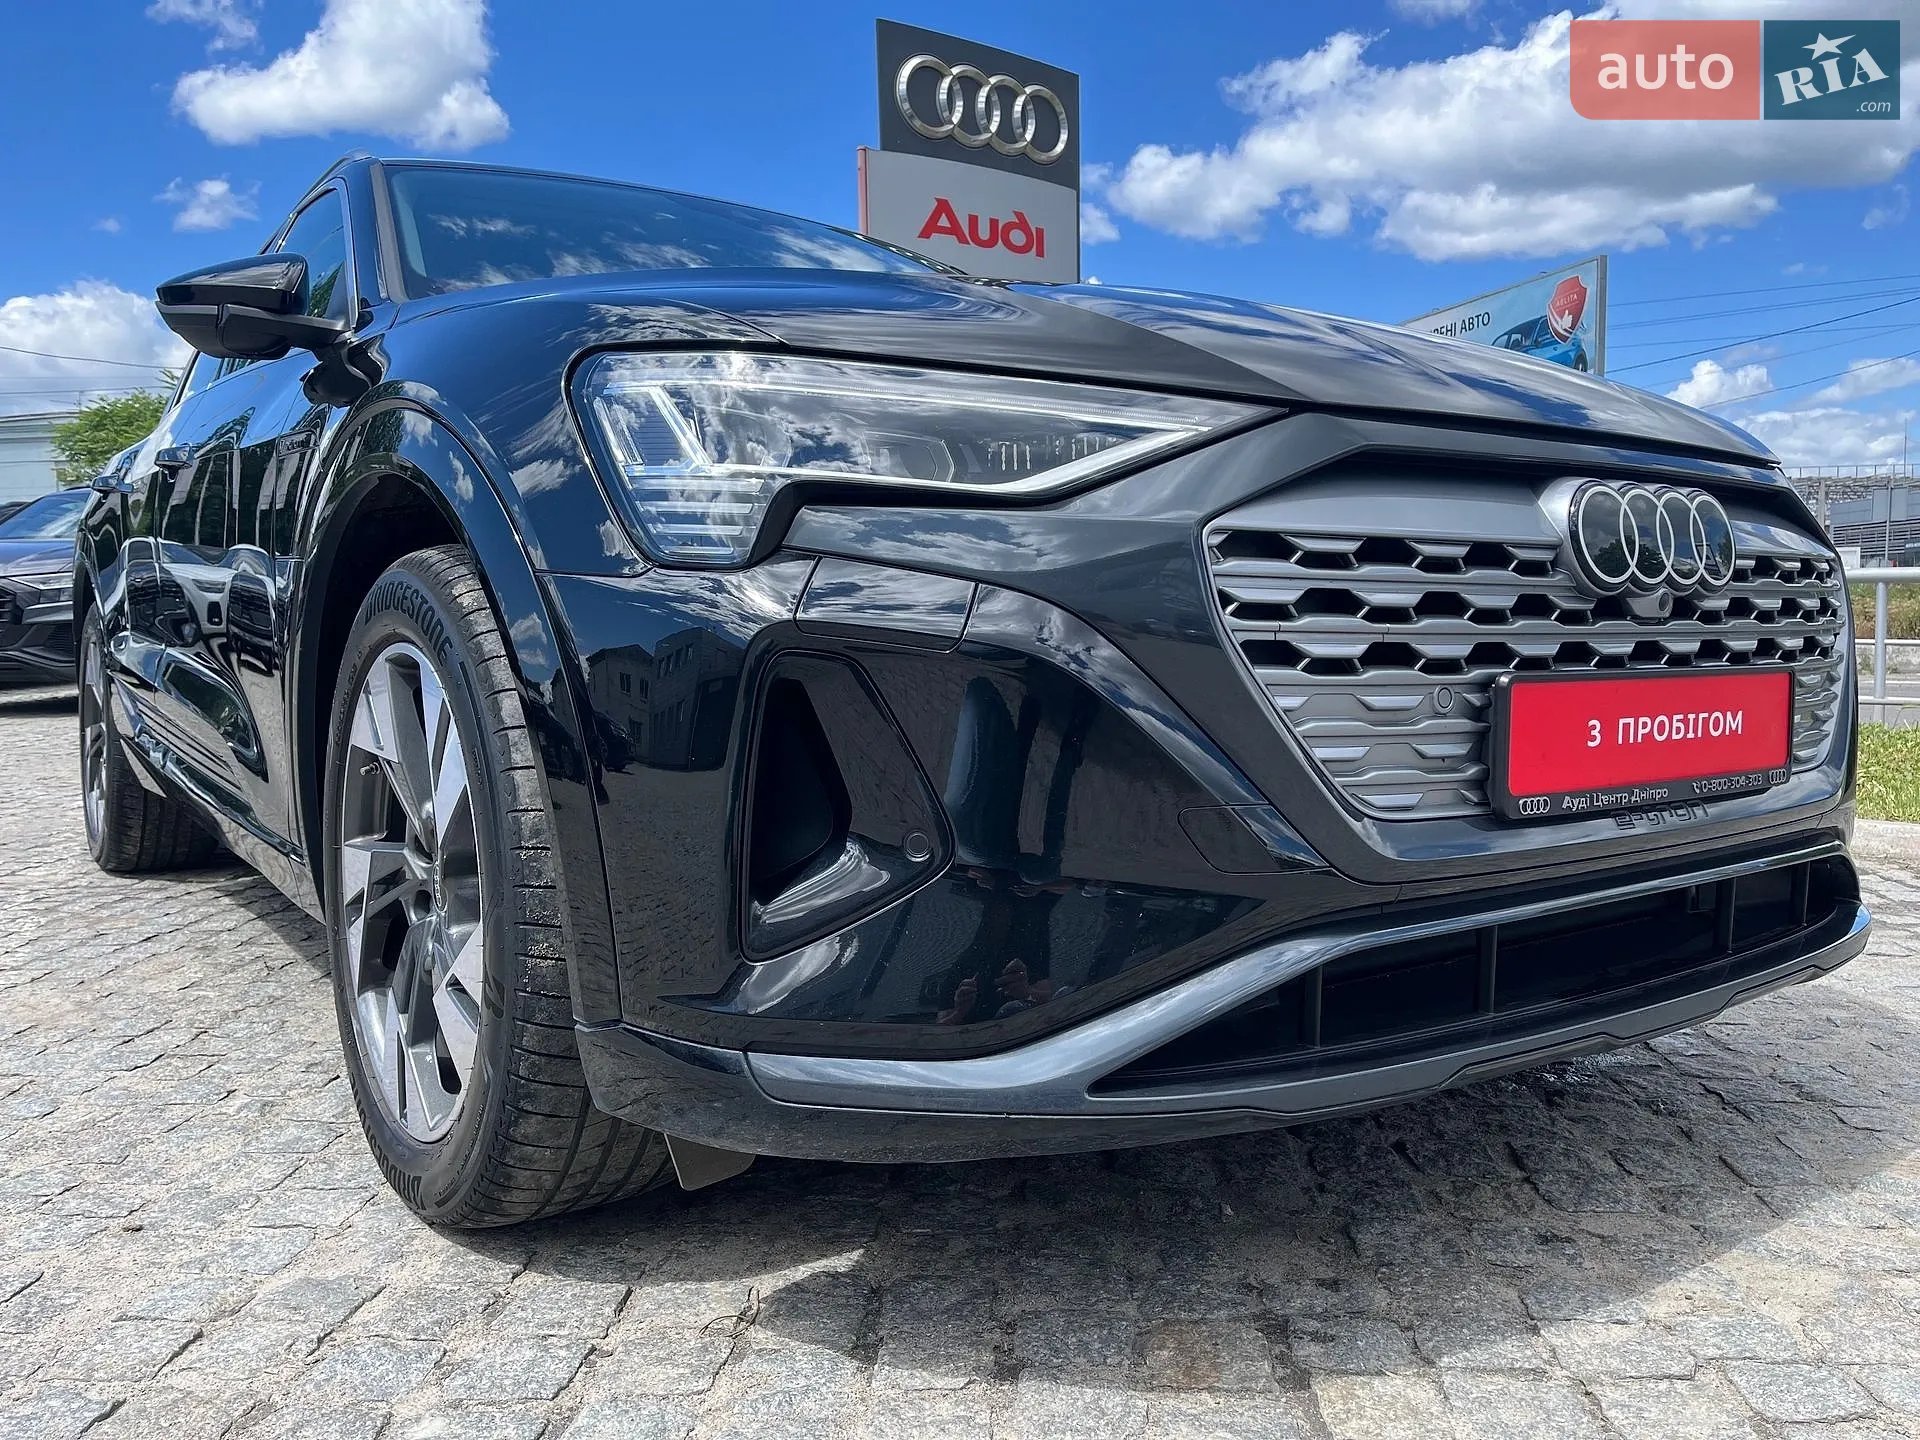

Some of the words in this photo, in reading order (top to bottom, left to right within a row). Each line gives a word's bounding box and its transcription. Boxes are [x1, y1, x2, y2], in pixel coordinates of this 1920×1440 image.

[917, 197, 1045, 258] Audi
[1460, 312, 1490, 334] АВТО
[364, 581, 453, 667] BRIDGESTONE
[1617, 710, 1743, 744] ПРОБІГОМ
[1702, 774, 1762, 792] 0-800-304-303
[1562, 794, 1590, 811] Ауді
[1592, 792, 1628, 807] Центр
[1631, 787, 1669, 804] Дніпро
